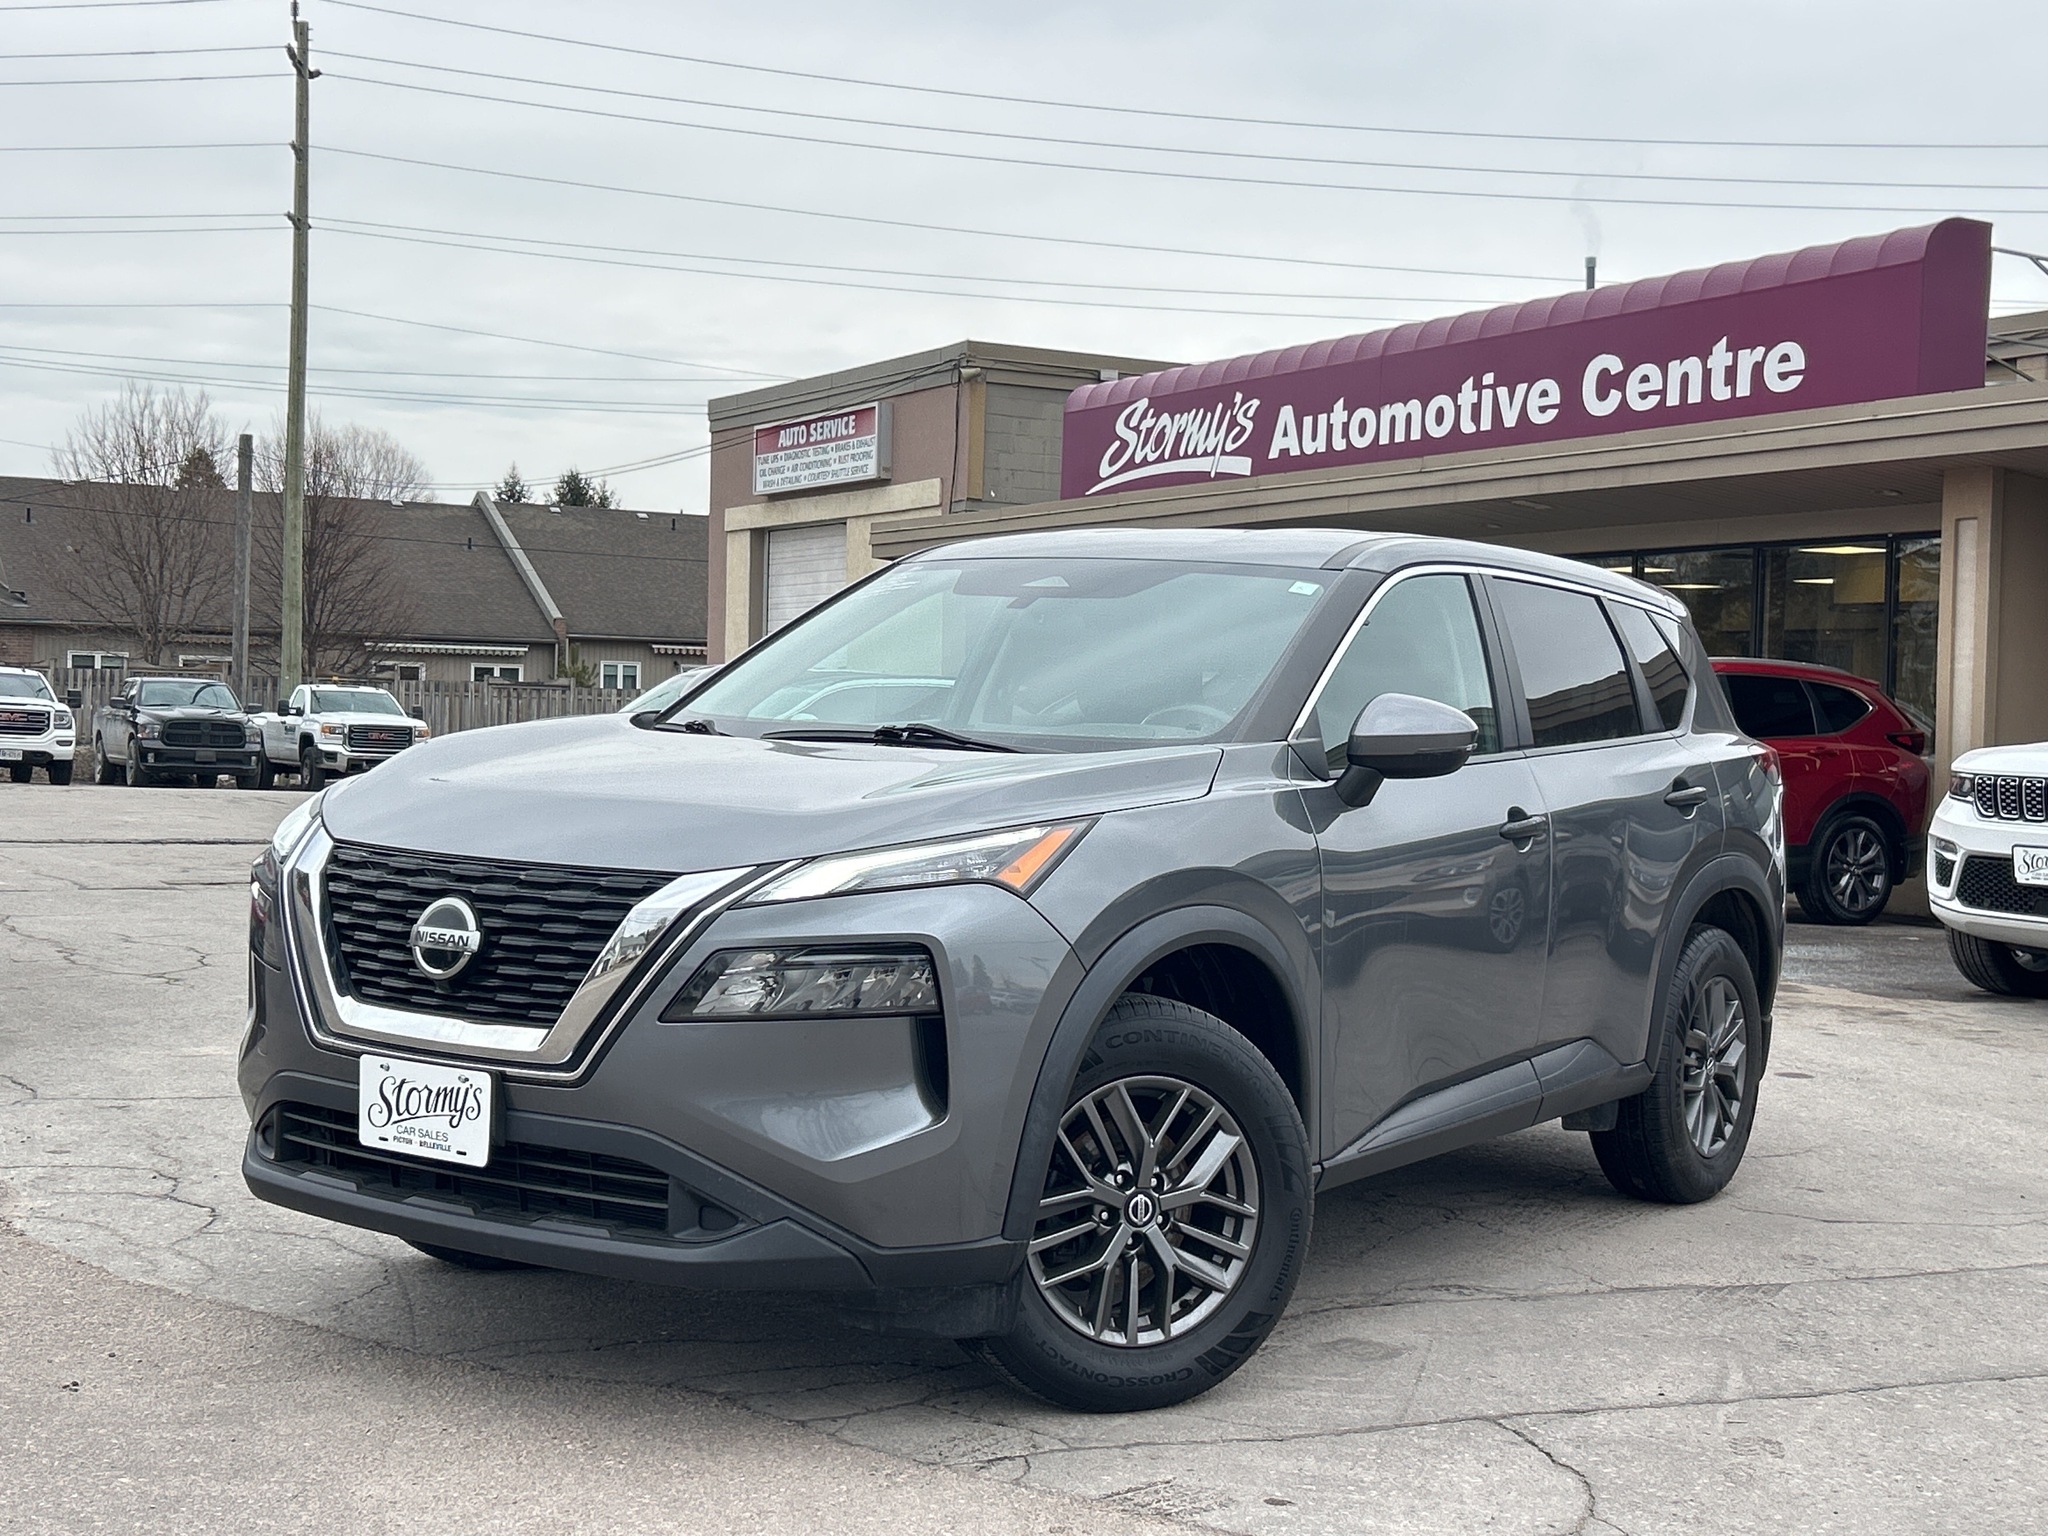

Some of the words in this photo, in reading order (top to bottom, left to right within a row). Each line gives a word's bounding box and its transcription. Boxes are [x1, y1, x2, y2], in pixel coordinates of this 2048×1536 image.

[1099, 391, 1261, 479] Stormy's
[1268, 372, 1562, 460] Automotive
[1582, 336, 1807, 417] Centre
[778, 425, 807, 448] AUTO
[809, 415, 856, 443] SERVICE
[758, 455, 770, 466] TUNE
[771, 454, 779, 464] UPS
[784, 448, 811, 462] DIAGNOSTIC
[768, 465, 786, 477] CHANGE
[791, 463, 799, 473] AIR
[800, 457, 832, 472] CONDITIONING
[850, 464, 869, 476] SERVICE
[368, 732, 395, 740] GMC
[416, 930, 470, 947] NISSAN
[367, 1076, 483, 1129] Stormy's
[396, 1124, 416, 1136] CAR
[418, 1128, 449, 1142] SALES
[419, 1140, 452, 1152] BELLEVILLE
